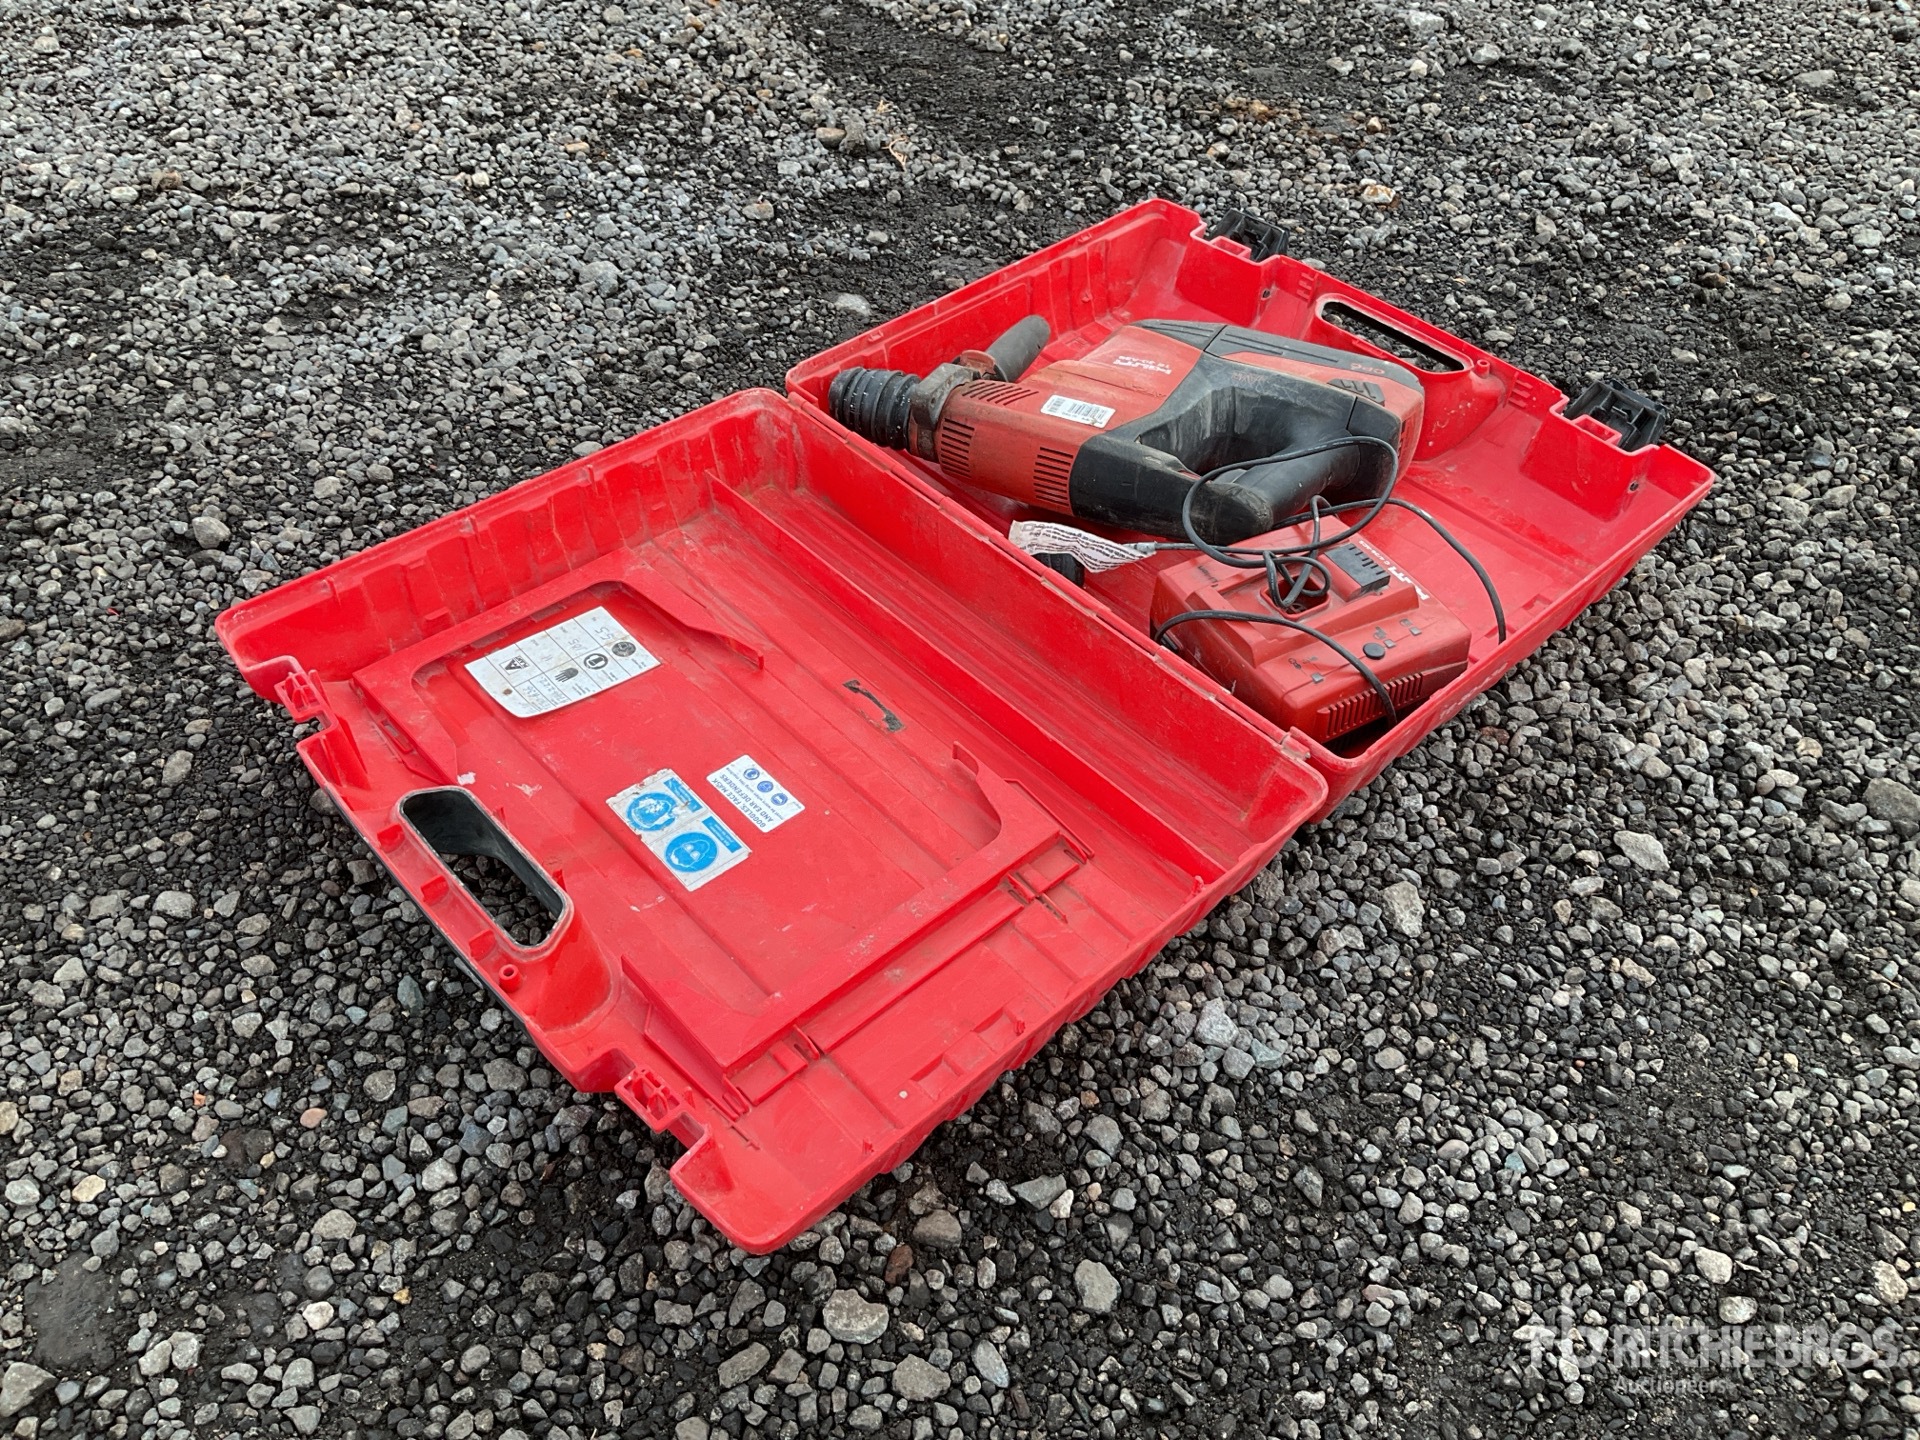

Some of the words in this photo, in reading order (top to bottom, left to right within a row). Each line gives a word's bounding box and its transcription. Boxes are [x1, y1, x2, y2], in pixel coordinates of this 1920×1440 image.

[710, 777, 729, 793] MASK
[718, 773, 752, 802] DEFENDERS
[725, 791, 742, 805] FACE
[748, 800, 762, 812] EAR
[759, 810, 774, 822] AND
